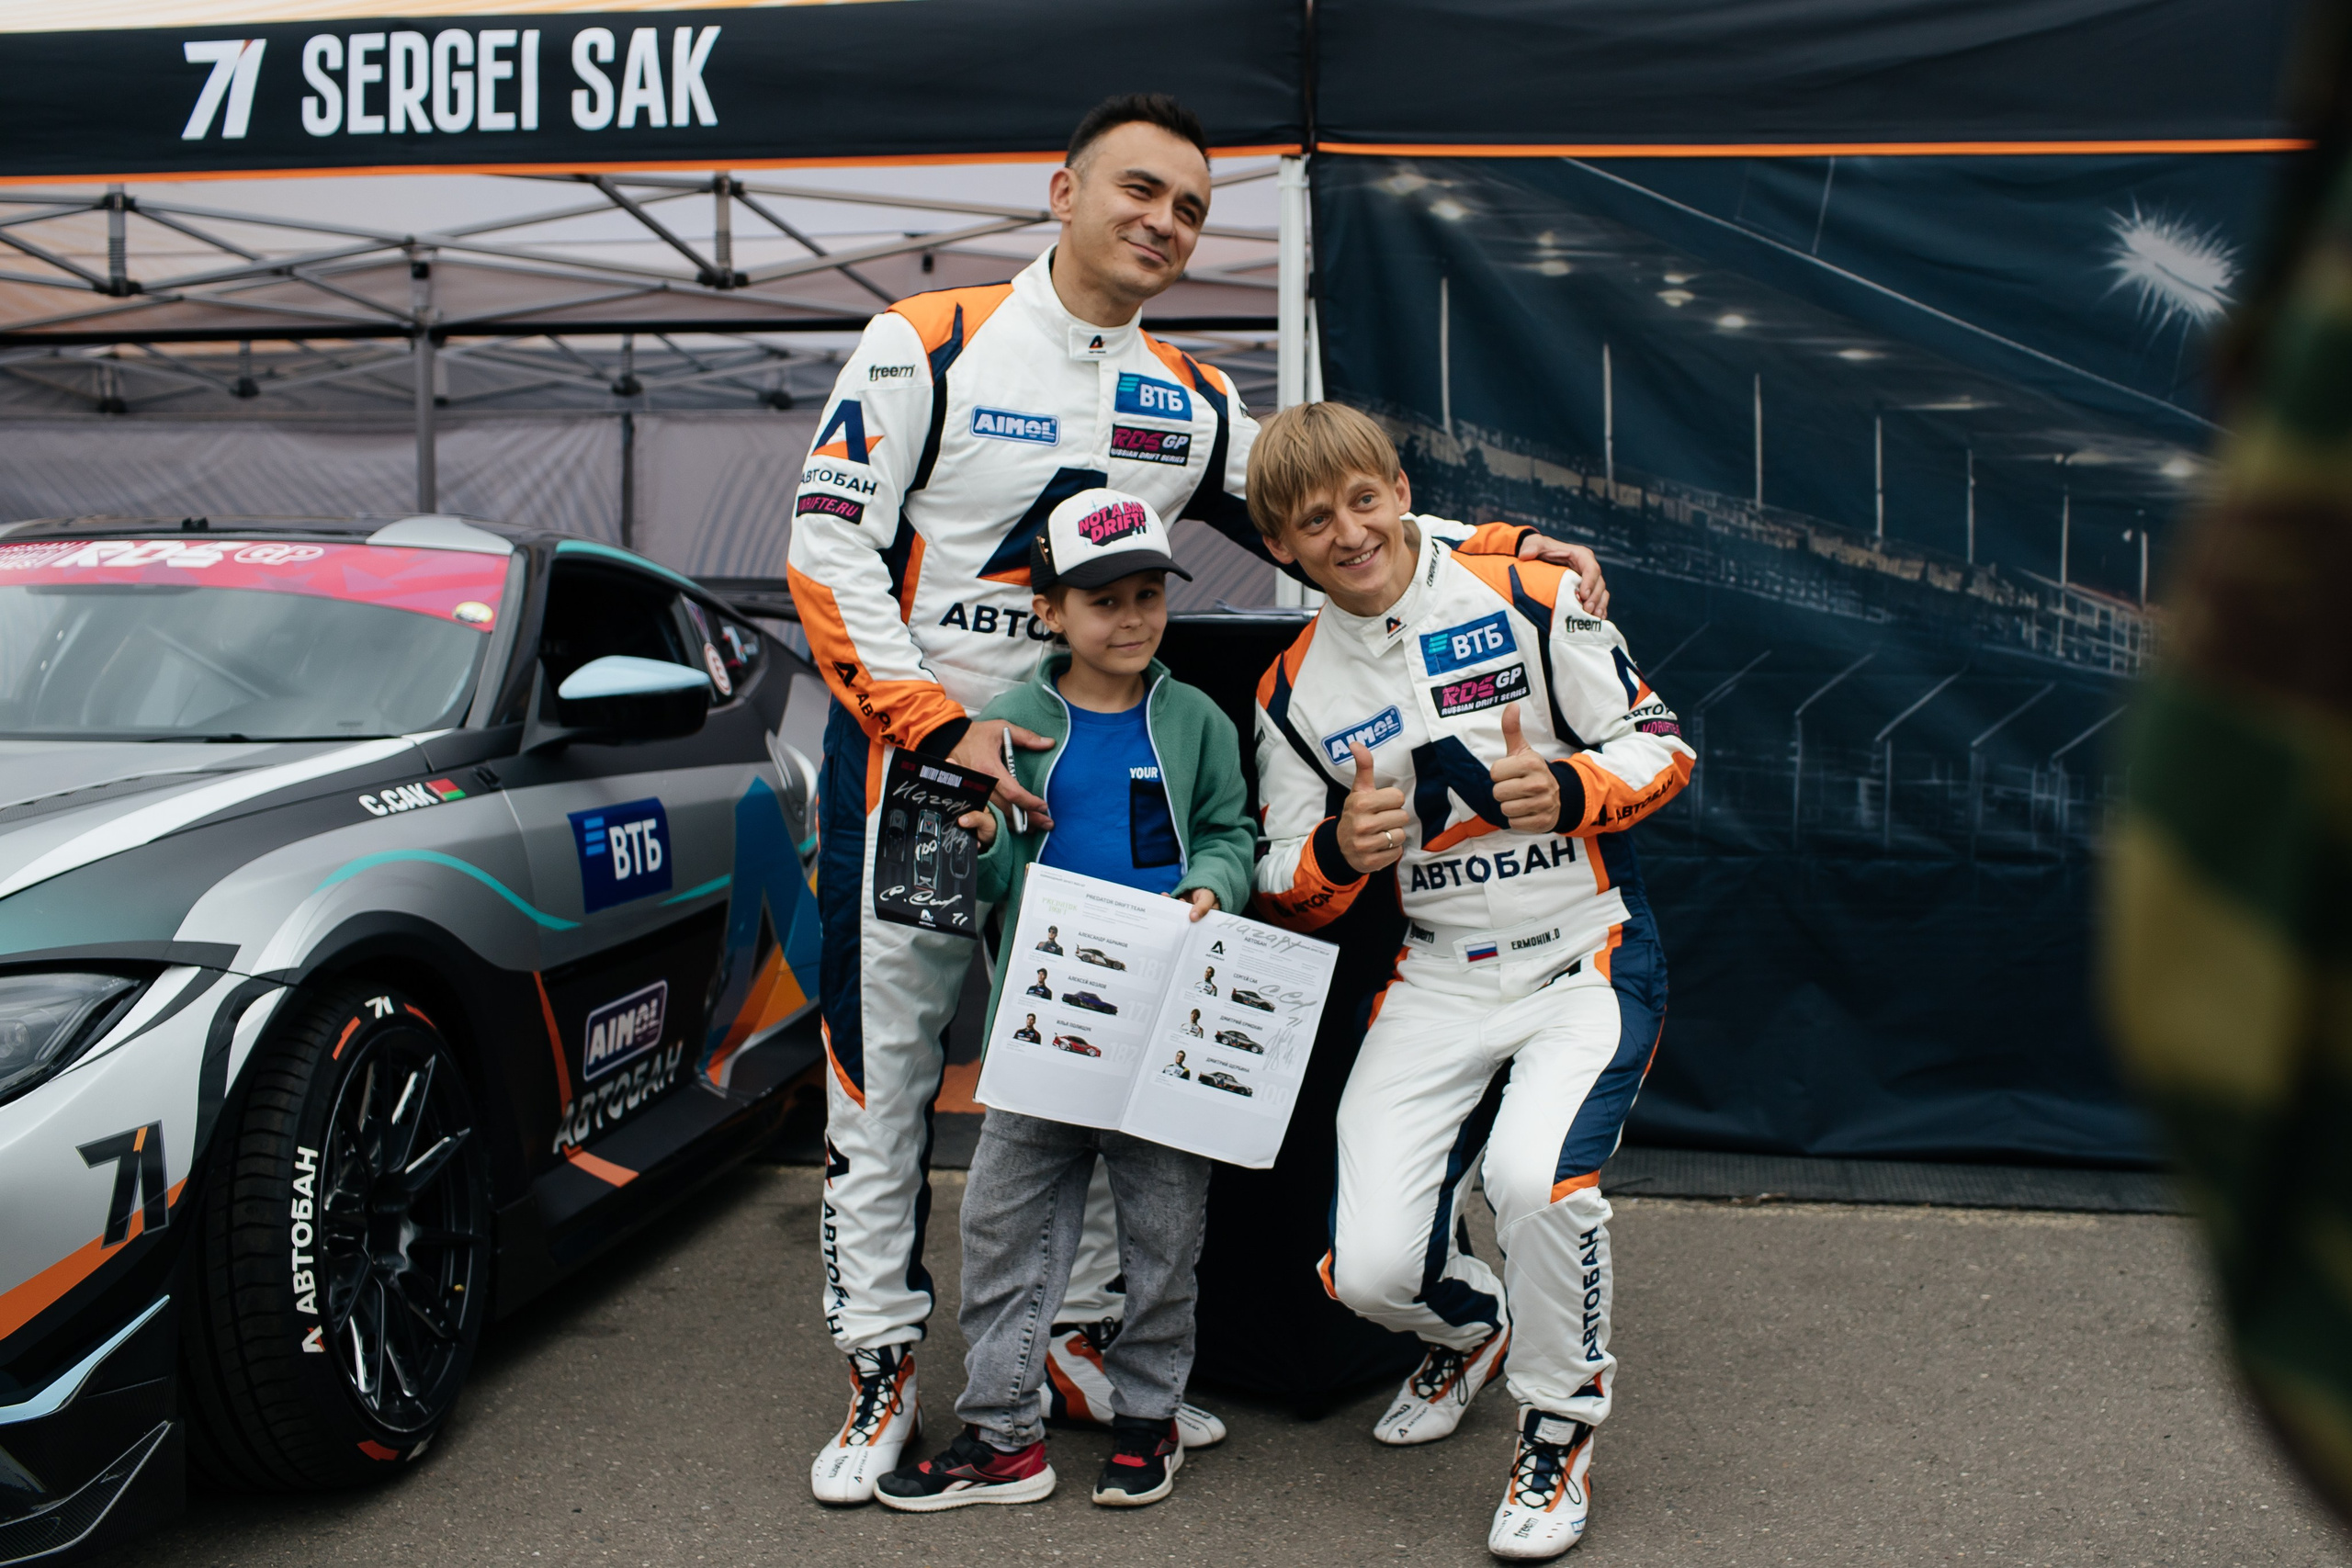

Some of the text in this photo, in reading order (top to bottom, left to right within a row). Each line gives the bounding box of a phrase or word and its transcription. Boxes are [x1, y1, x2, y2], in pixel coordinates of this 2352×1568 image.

[181, 25, 721, 141] 71 SERGEI SAK
[869, 364, 916, 382] freem
[1139, 384, 1183, 412] ВТБ
[974, 413, 1057, 438] AIMOL
[1113, 428, 1189, 451] RDS GP
[800, 469, 877, 495] АВТОБАН
[1079, 502, 1145, 536] NOT A BAD
[1091, 513, 1146, 544] DRIFT!
[939, 602, 1056, 641] АВТО
[1566, 615, 1602, 633] freem
[1452, 623, 1504, 660] ВТБ
[1442, 667, 1522, 707] RDS GP
[1442, 686, 1527, 716] RUSSIAN DRIFT SERIES
[1129, 766, 1158, 779] YOUR
[608, 818, 662, 881] ВТБ
[1411, 837, 1577, 893] АВТОБАН
[1086, 894, 1114, 905] PREDATOR
[1114, 900, 1130, 909] DRIFT
[1511, 928, 1560, 950] ERMOHIN.D
[365, 996, 394, 1019] 71
[74, 1119, 169, 1250] 71
[291, 1145, 318, 1315] АВТОБАН
[1578, 1225, 1604, 1362] АВТОБАН
